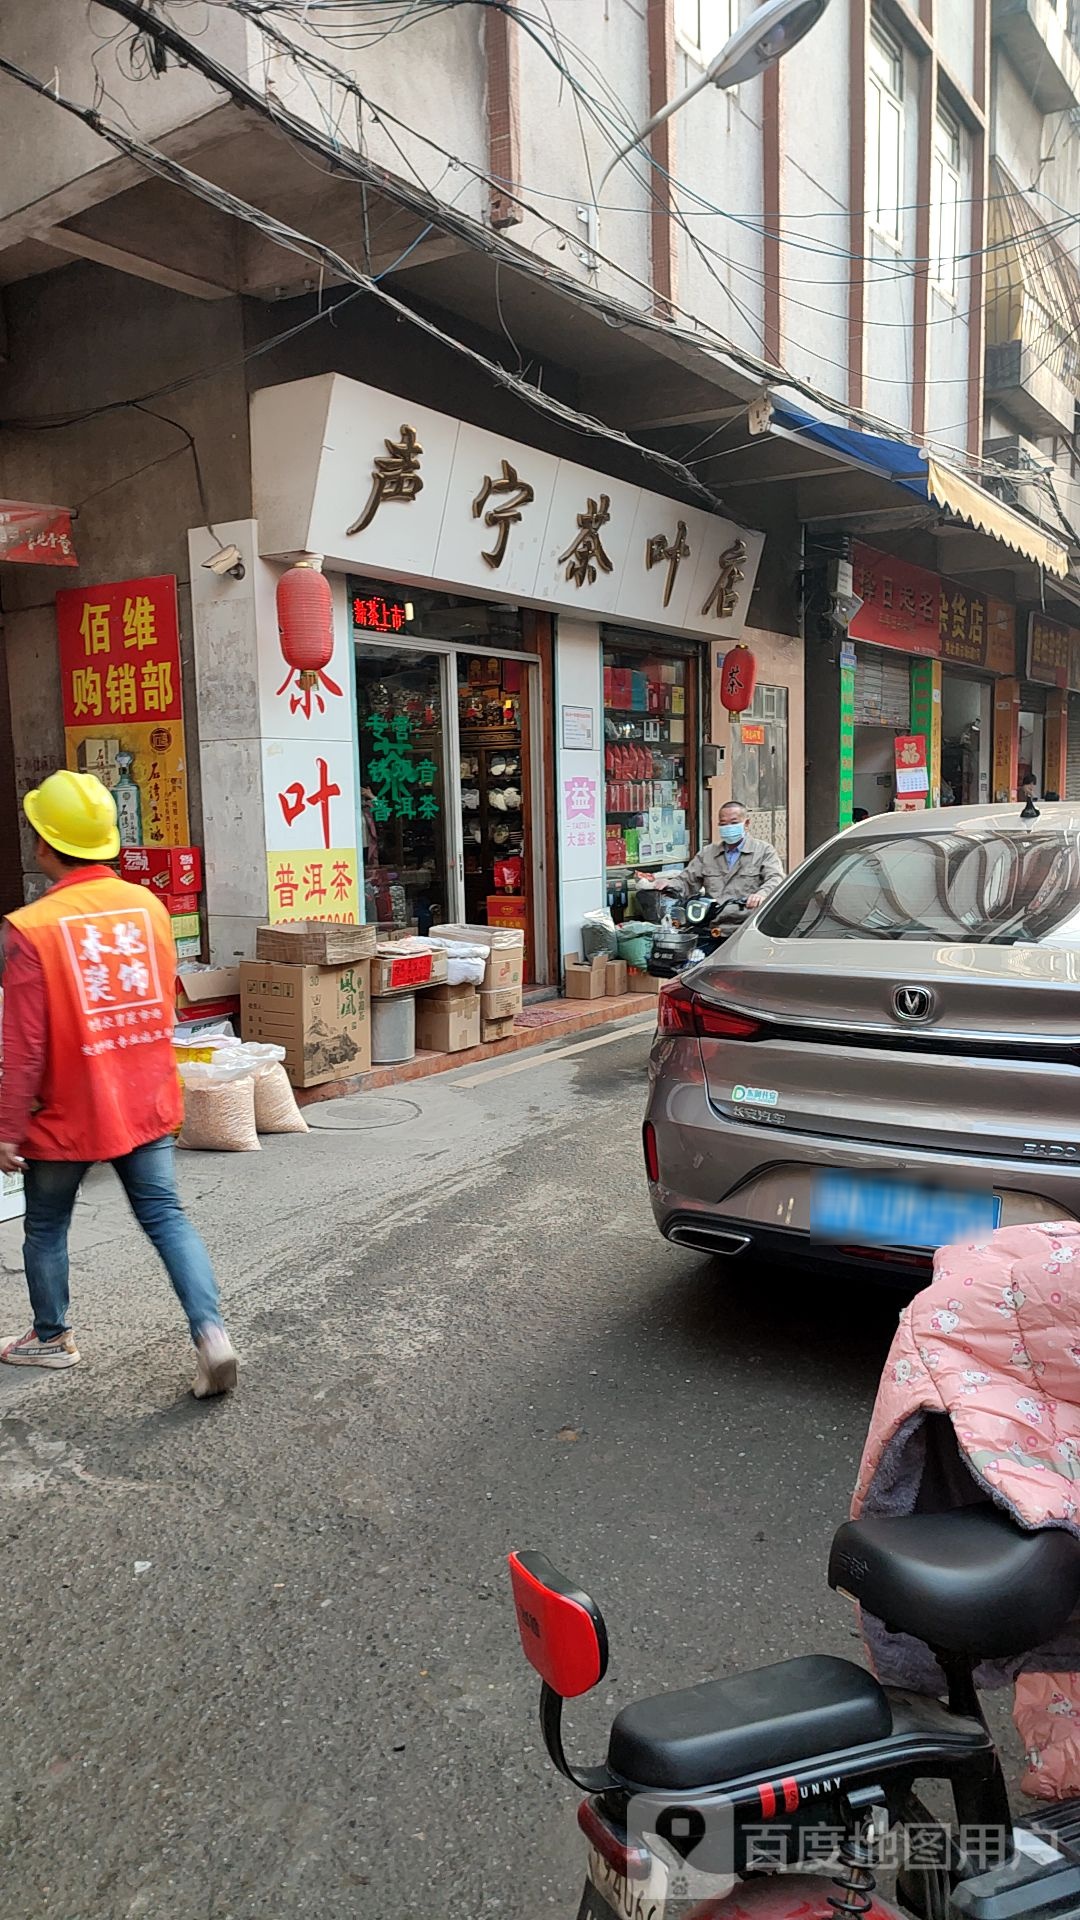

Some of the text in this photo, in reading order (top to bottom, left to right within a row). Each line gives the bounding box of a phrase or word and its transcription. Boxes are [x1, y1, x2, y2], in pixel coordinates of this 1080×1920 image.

[346, 424, 748, 618] 声宁茶叶店
[79, 596, 158, 656] 佰维
[353, 598, 405, 631] 新茶上市
[71, 660, 174, 717] 购销部
[728, 665, 743, 694] 茶
[369, 794, 440, 822] 普洱茶
[274, 861, 353, 909] 普洱茶
[734, 1105, 786, 1124] 长安汽车
